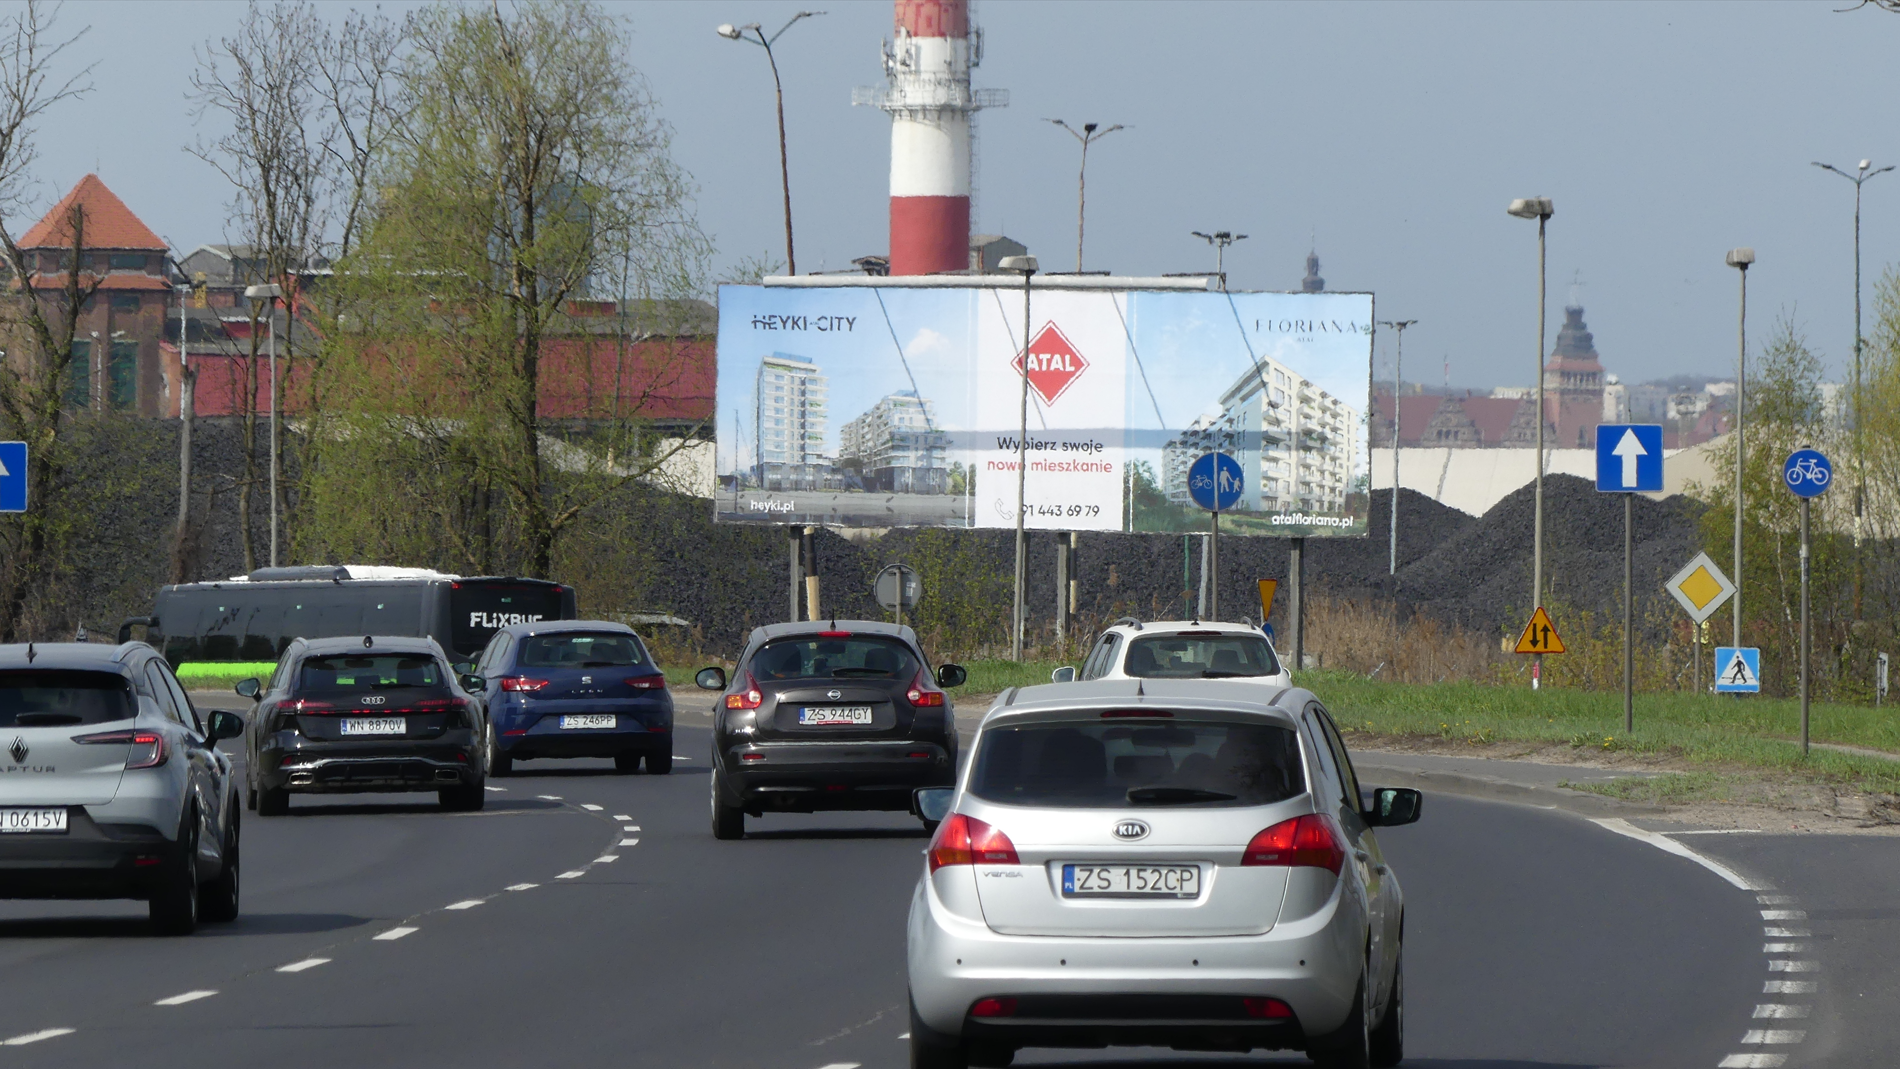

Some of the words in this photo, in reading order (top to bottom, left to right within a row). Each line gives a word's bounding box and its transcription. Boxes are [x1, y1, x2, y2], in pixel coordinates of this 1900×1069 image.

[751, 315, 807, 331] HEYKI
[817, 316, 857, 332] CITY
[1255, 319, 1357, 333] FLORIANA
[1028, 353, 1076, 372] ATAL
[1061, 439, 1104, 455] swoje
[1031, 458, 1113, 473] mieszkanie
[750, 499, 795, 513] heyki.pl
[1038, 505, 1062, 517] 443
[1066, 505, 1082, 517] 69
[1085, 505, 1100, 518] 79
[1271, 512, 1354, 529] atalfloriana.pl
[566, 715, 579, 726] ZS
[583, 715, 613, 726] 246PP
[806, 708, 826, 721] ZS
[830, 707, 869, 721] 944GY
[349, 720, 364, 732] WN
[368, 719, 402, 731] 8870V
[10, 811, 62, 828] 0615V
[1119, 825, 1141, 835] KIA
[1079, 868, 1112, 891] ZS
[1123, 868, 1194, 892] 152CP
